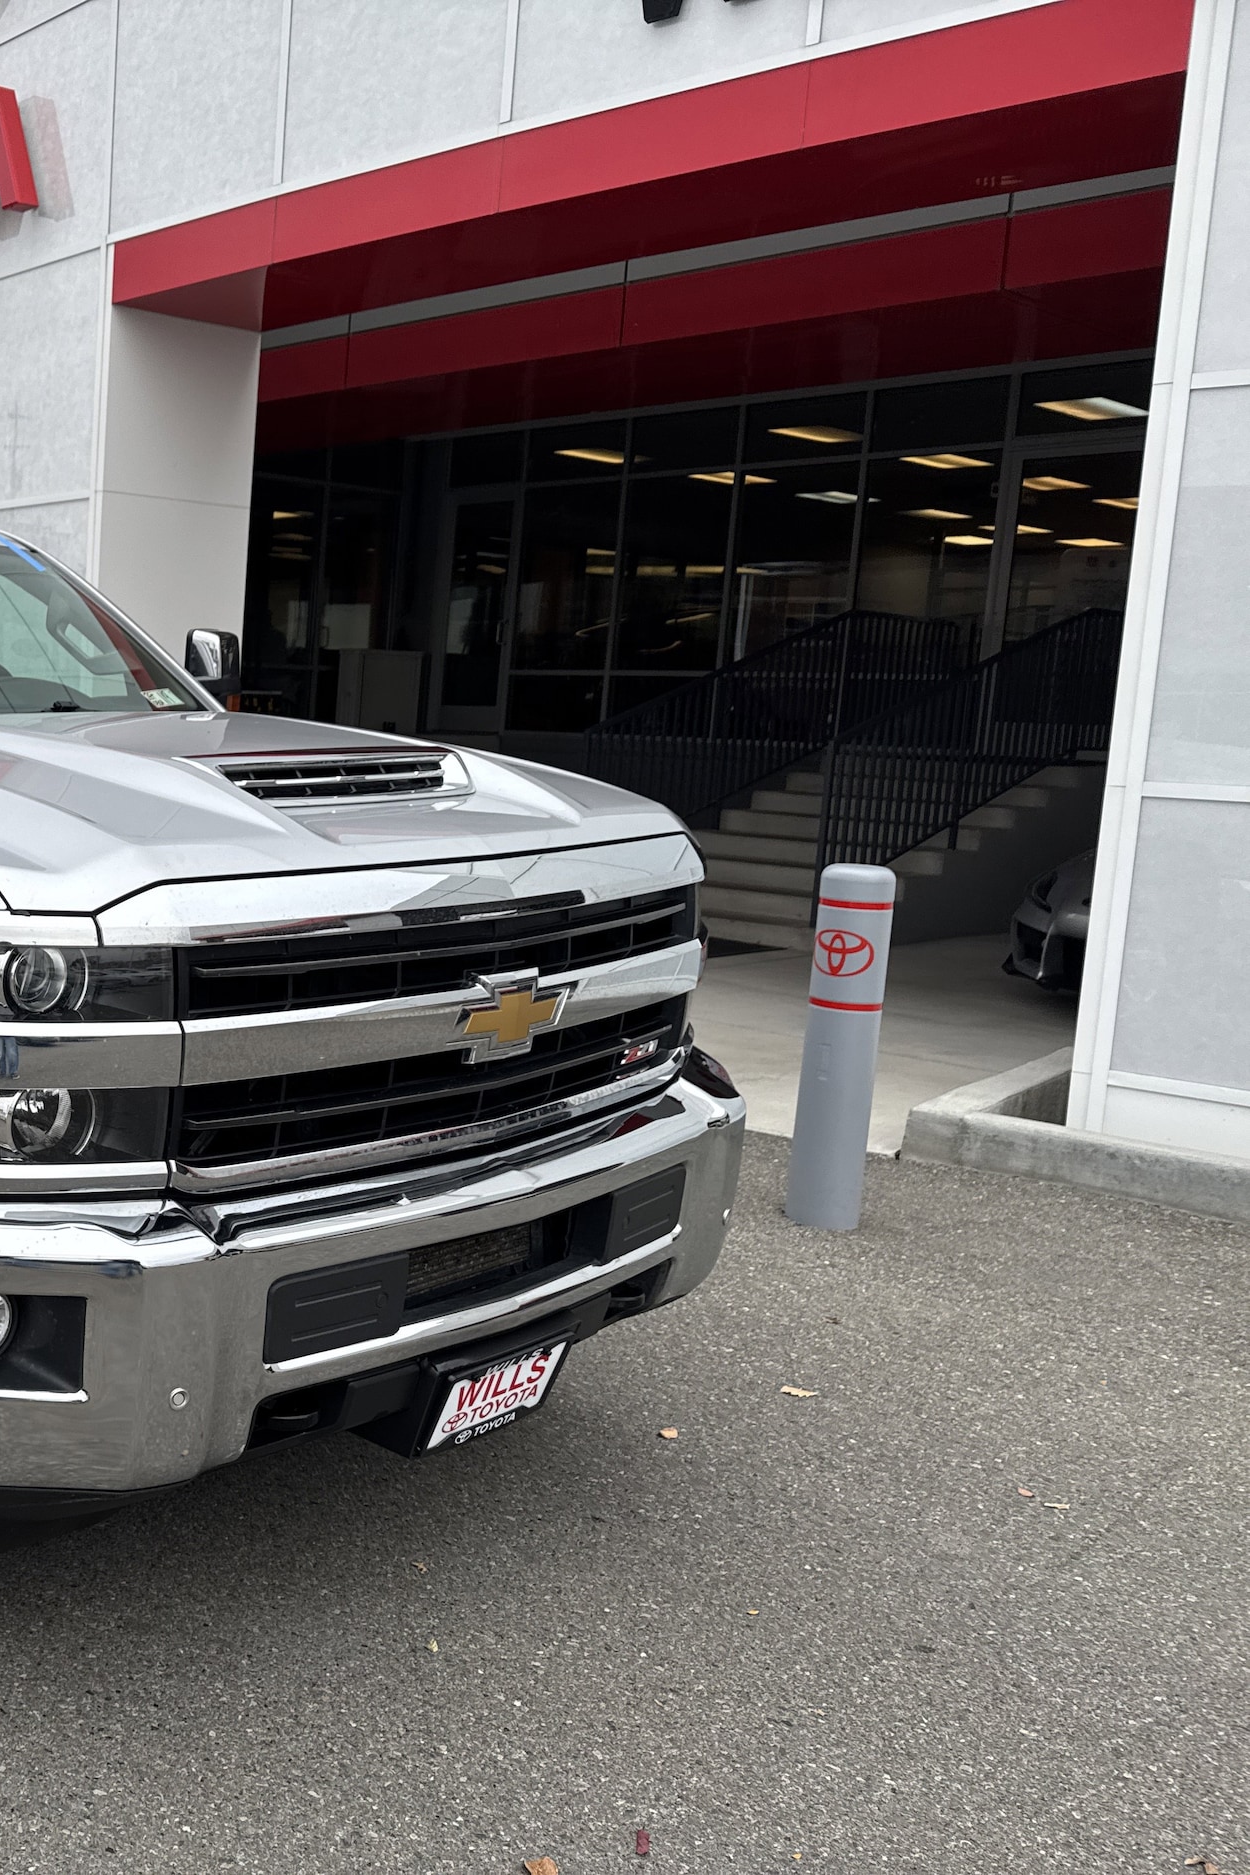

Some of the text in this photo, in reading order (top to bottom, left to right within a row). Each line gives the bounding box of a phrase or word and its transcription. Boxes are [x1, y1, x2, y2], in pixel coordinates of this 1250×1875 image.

[457, 1355, 549, 1411] WILLS
[470, 1384, 538, 1423] TOYOTA
[473, 1411, 516, 1436] TOYOTA
